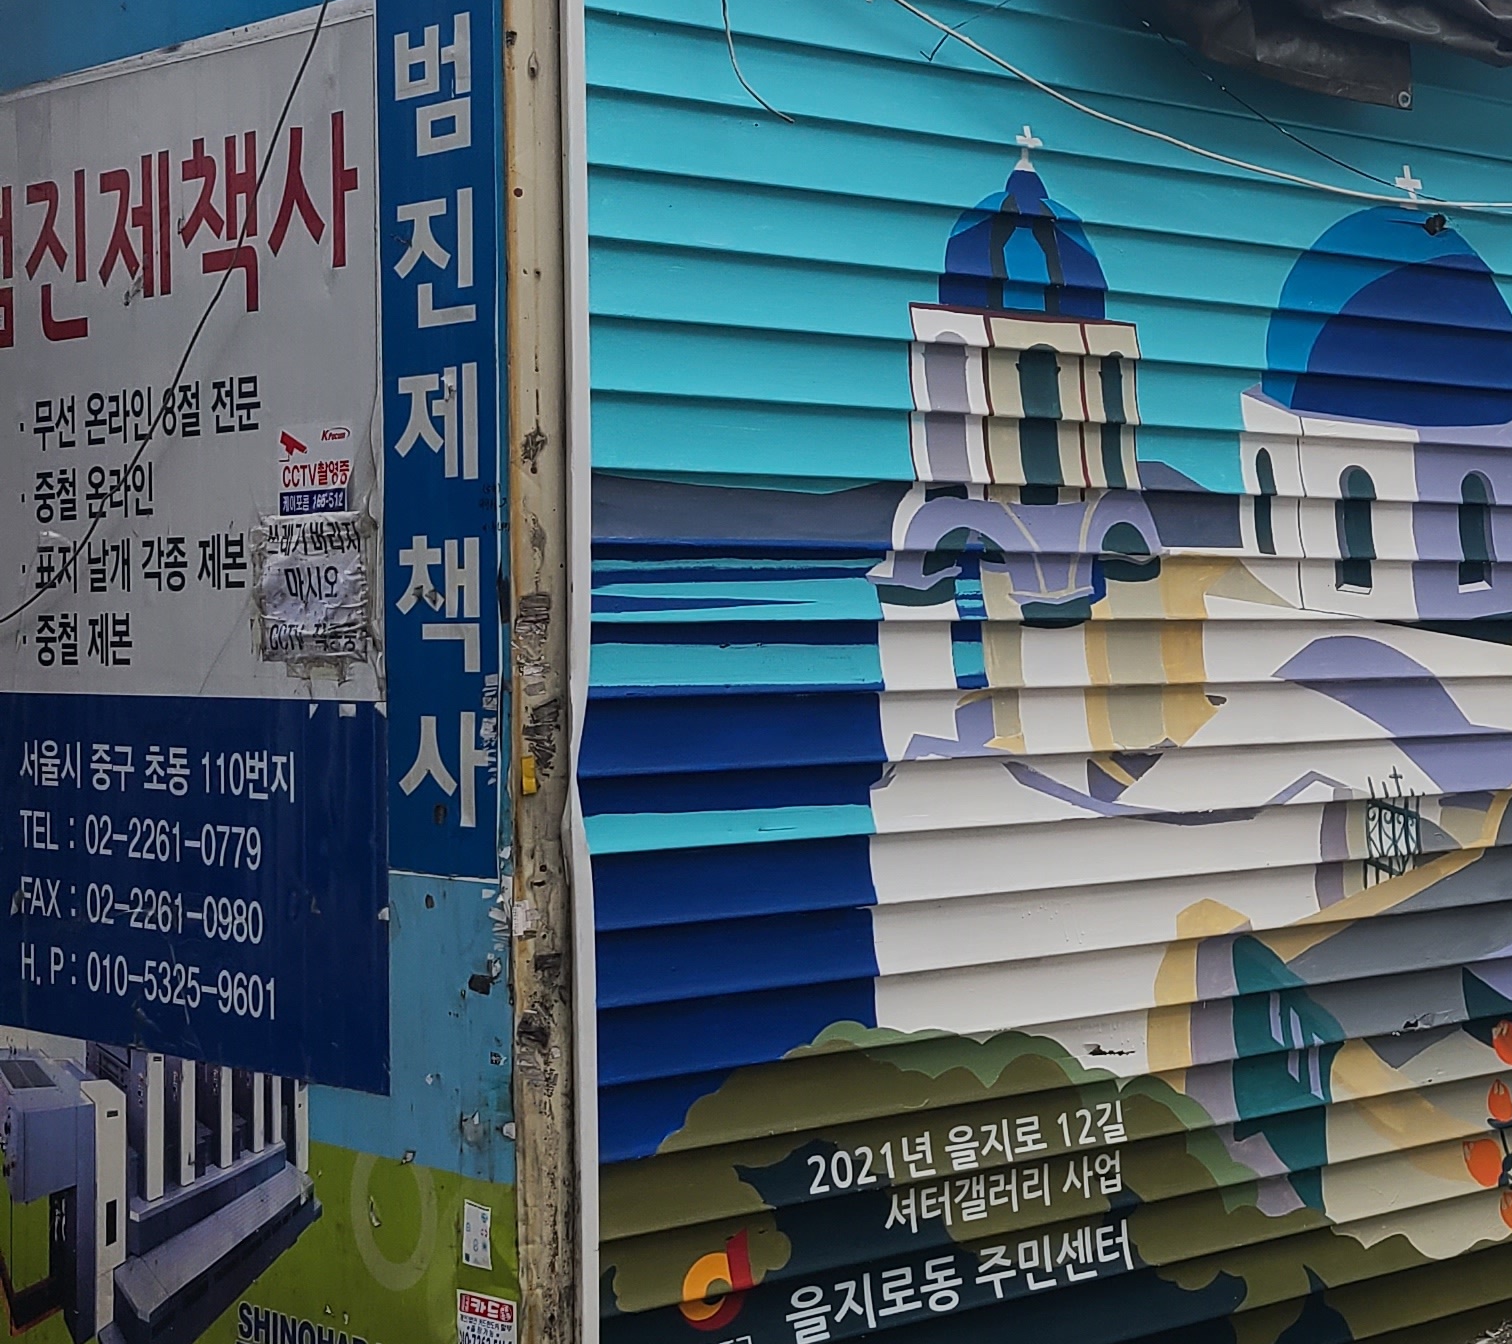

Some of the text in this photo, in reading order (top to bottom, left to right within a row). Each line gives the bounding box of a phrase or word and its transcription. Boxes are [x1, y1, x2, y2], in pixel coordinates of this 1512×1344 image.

[33, 394, 76, 452] 무선
[84, 386, 153, 446] 온라인
[211, 375, 261, 435] 전문
[393, 10, 490, 828] 범진제책사
[33, 461, 154, 524] 중철 온라인
[35, 532, 248, 594] 표지 날개 각종 제본
[309, 521, 361, 555] 버리지
[284, 565, 339, 601] 마시오
[35, 612, 133, 667] 중철 제본
[19, 739, 295, 803] 서울시 중구 초동 110번지
[19, 809, 59, 851] TEL
[85, 814, 262, 871] 02-2261-0779
[20, 875, 62, 918] FAX
[86, 882, 264, 944] 02-2261-0980
[86, 951, 276, 1021] 010-5325-9601
[806, 1099, 1129, 1195] 2021년 을지로 12길
[884, 1149, 1123, 1234] 셔터갤러리 사업
[974, 1218, 1136, 1300] 주민센터
[470, 1297, 501, 1319] 카드
